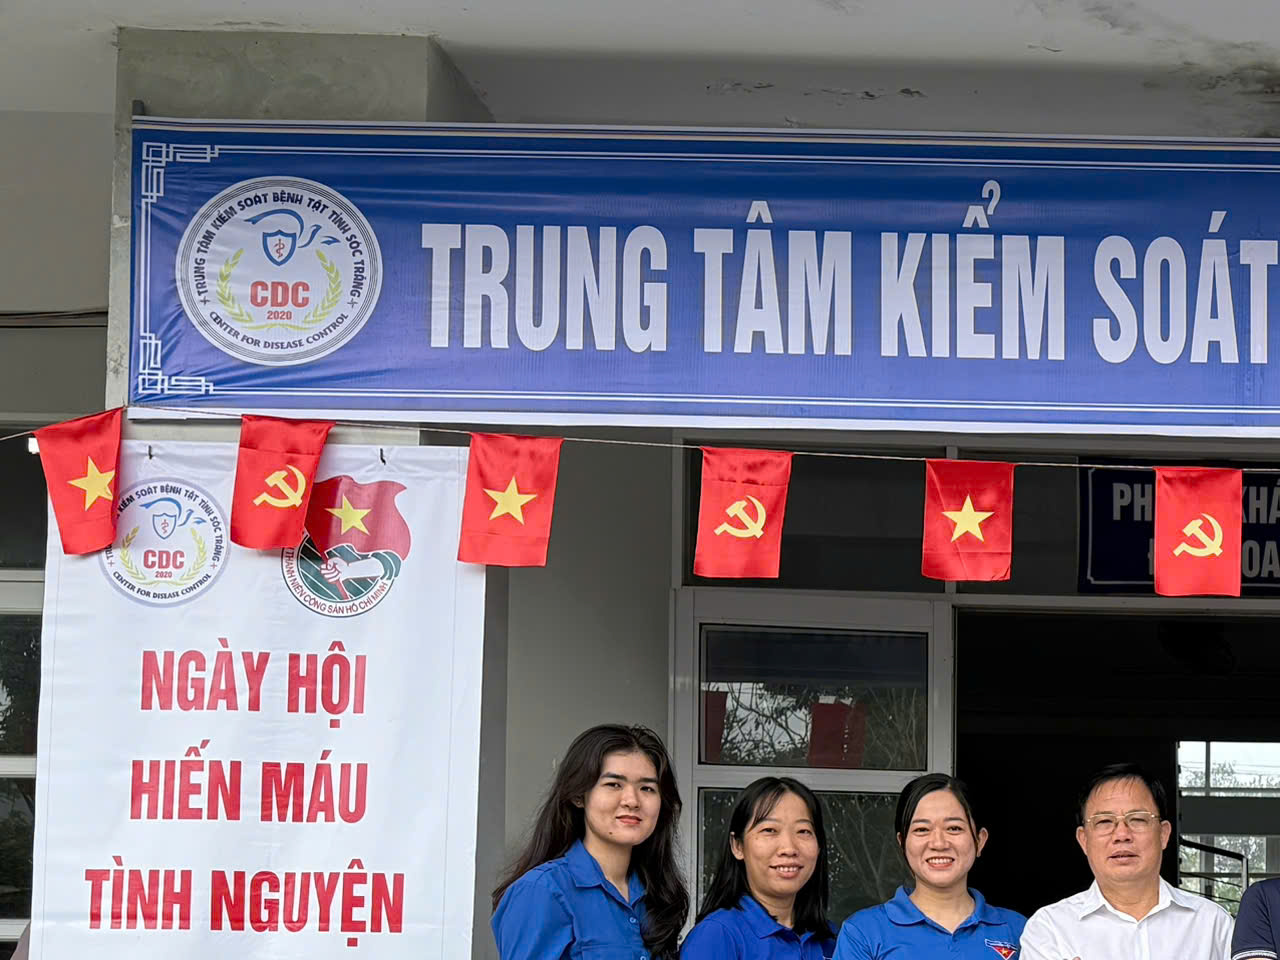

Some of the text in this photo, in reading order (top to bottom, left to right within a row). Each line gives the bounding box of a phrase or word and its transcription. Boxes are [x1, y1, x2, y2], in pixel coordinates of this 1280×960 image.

[237, 192, 269, 212] SOÁT
[272, 190, 303, 205] BỆNH
[307, 197, 329, 215] TẬT
[327, 209, 351, 235] TỈNH
[197, 229, 217, 254] TÂM
[345, 234, 363, 258] SÓC
[194, 257, 209, 297] TRUNG
[350, 259, 366, 299] TRĂNG
[420, 222, 668, 353] TRUNG
[693, 201, 852, 356] TÂM
[880, 179, 1065, 360] KIỂM
[1092, 211, 1279, 364] SOÁT
[250, 281, 311, 308] CDC
[266, 311, 292, 321] 2020
[209, 311, 349, 350] CENTER FOR DISEASE CONTROL
[143, 549, 185, 569] CDC
[113, 571, 212, 599] CENTER FOR DISEASE CONTROL
[140, 637, 367, 728] NGÀY HỘI
[129, 739, 368, 823] HIẾN MÁU
[85, 855, 404, 947] TÌNH NGUYỆN
